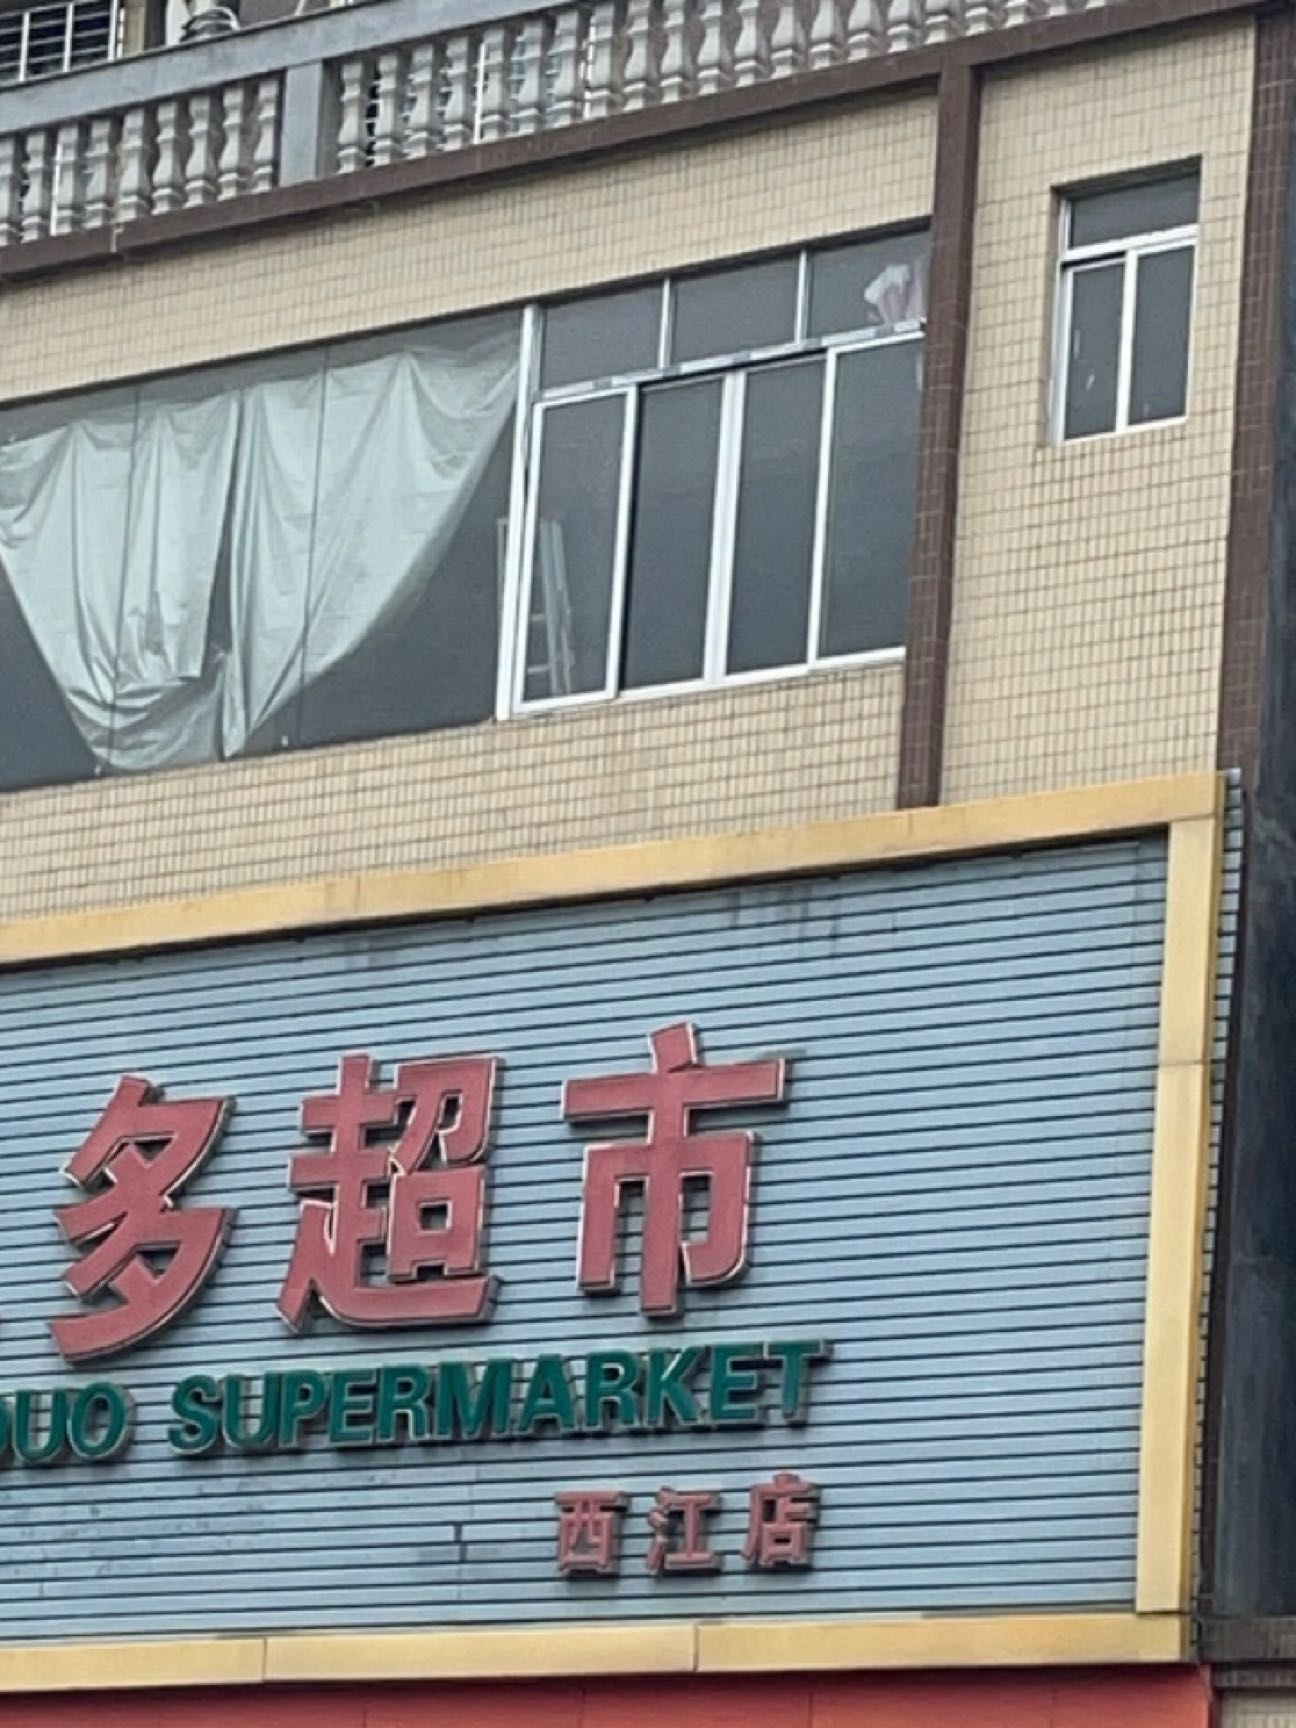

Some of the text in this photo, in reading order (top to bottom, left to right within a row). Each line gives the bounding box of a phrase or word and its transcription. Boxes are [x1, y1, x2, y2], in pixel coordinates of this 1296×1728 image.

[169, 1338, 835, 1459] SUPERMARKET
[553, 1471, 823, 1579] 西江店
